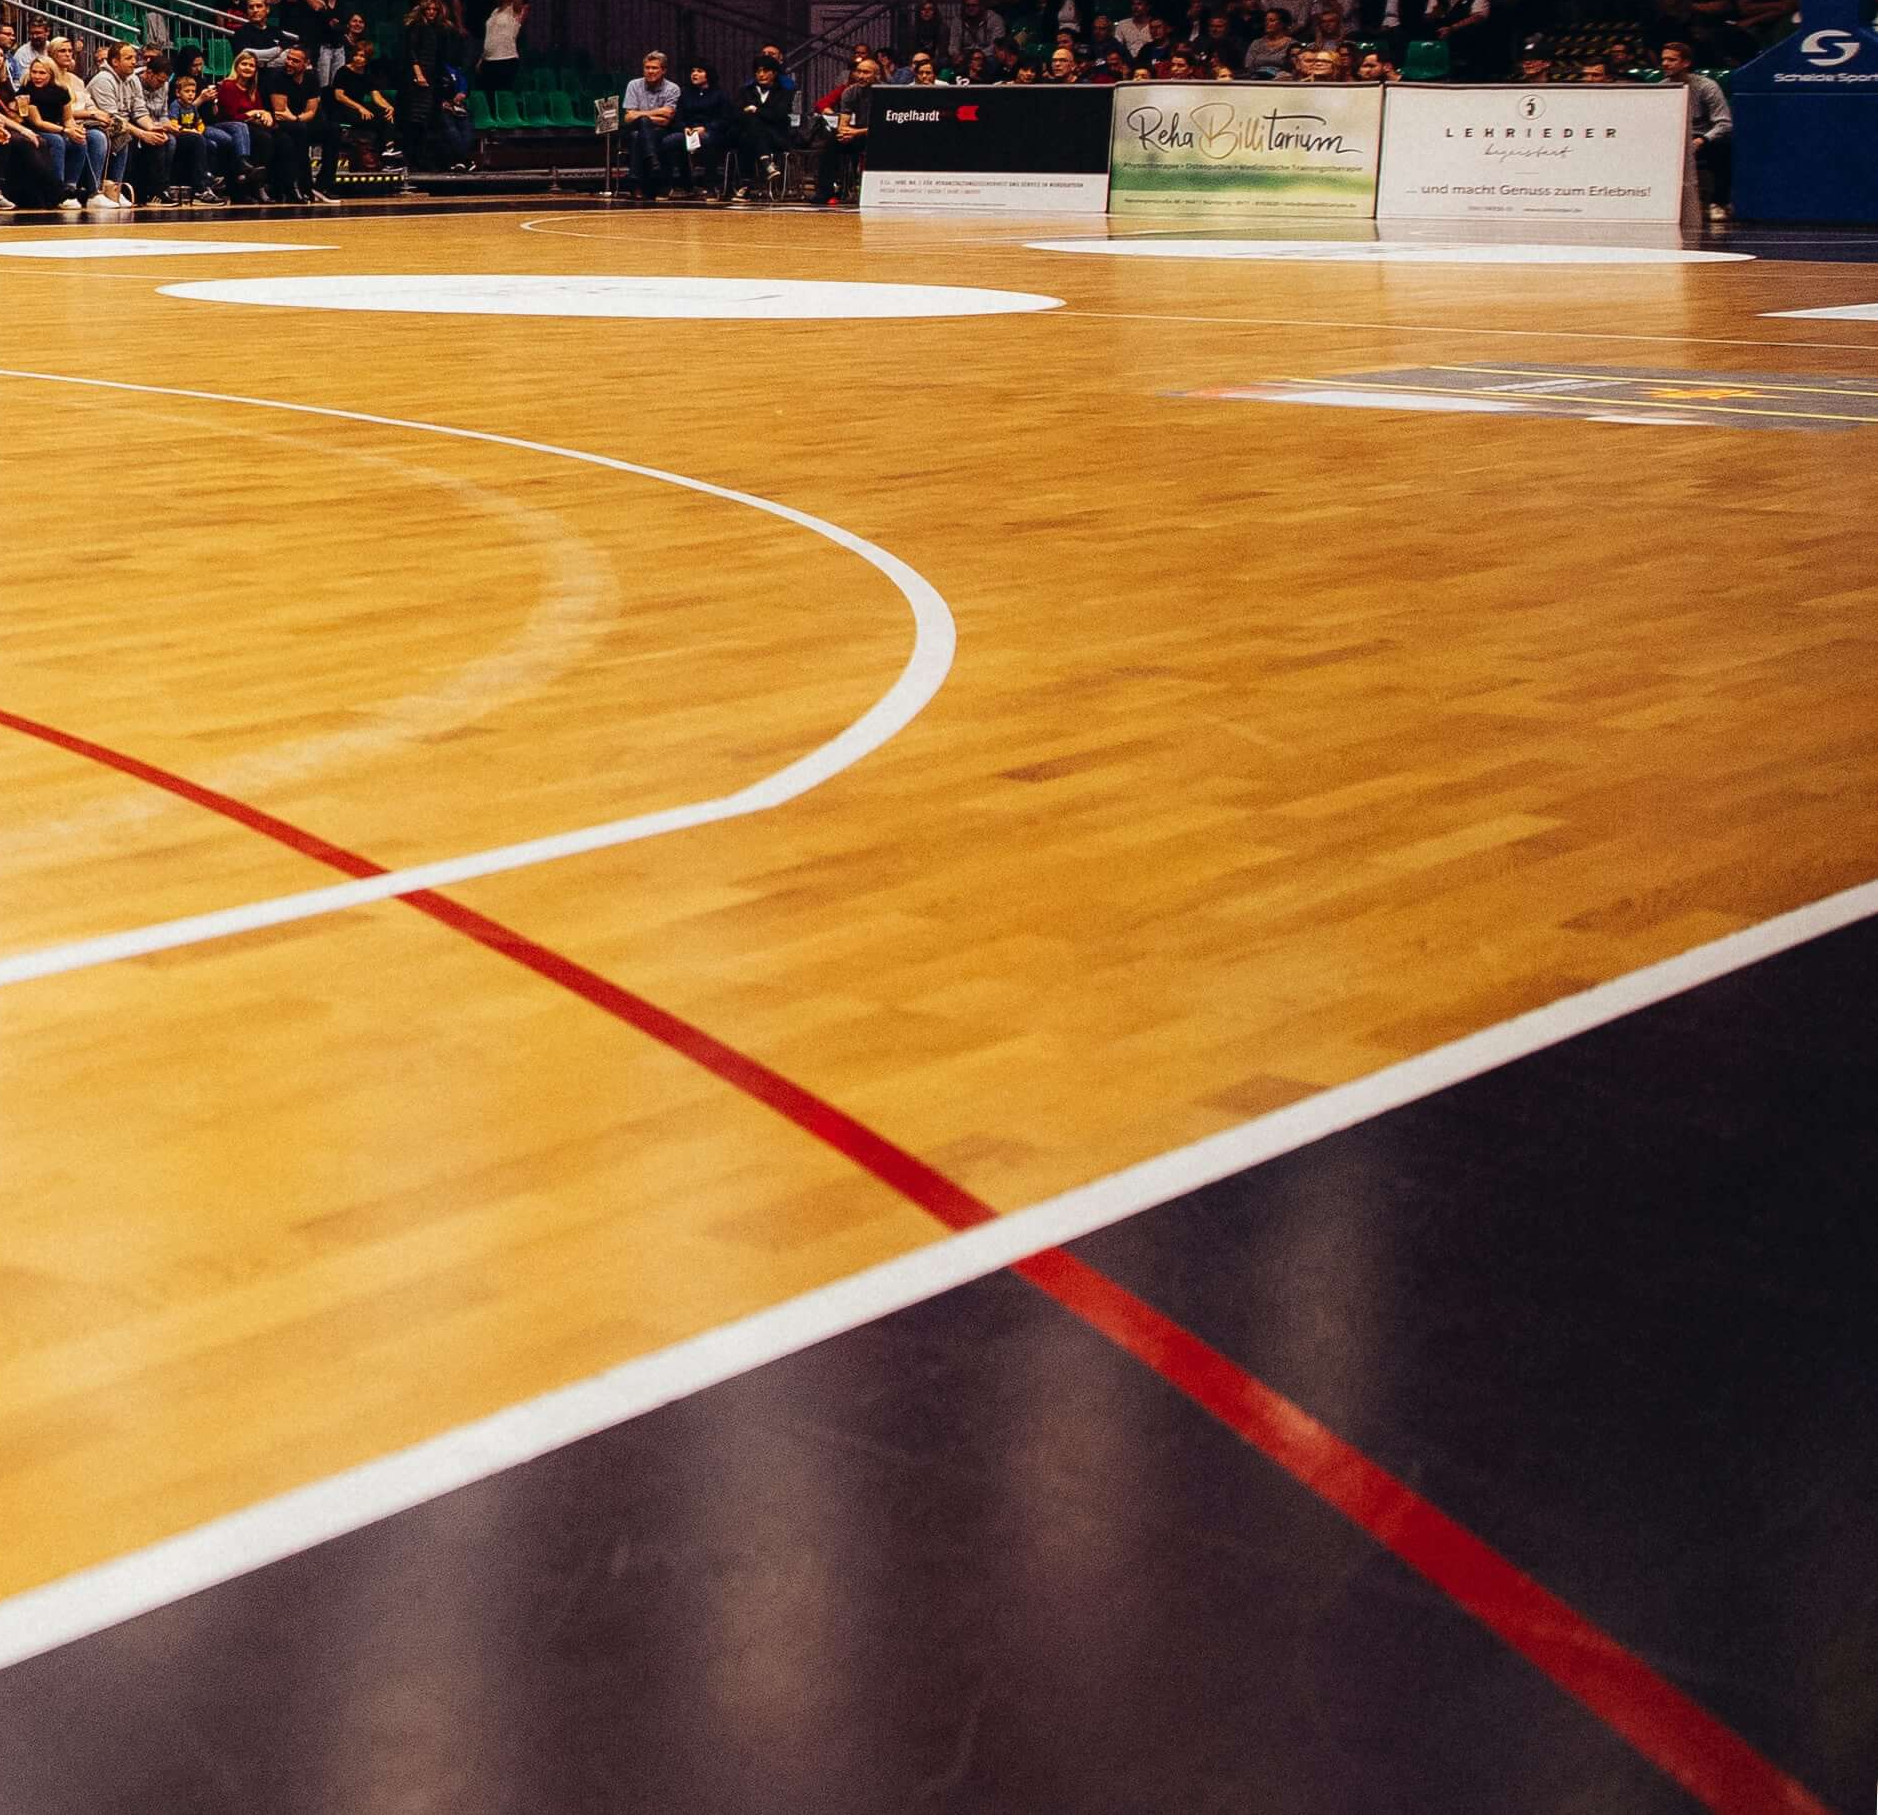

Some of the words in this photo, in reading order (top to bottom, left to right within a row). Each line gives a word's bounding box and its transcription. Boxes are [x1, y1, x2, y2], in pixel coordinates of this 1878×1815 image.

[886, 109, 940, 124] Engelhardt
[1445, 127, 1619, 139] LEHRIEDER
[1422, 184, 1449, 195] und
[1453, 185, 1496, 196] macht
[1500, 185, 1551, 196] Genuss
[1554, 188, 1586, 197] zum
[1589, 186, 1652, 198] Erlebnis!
